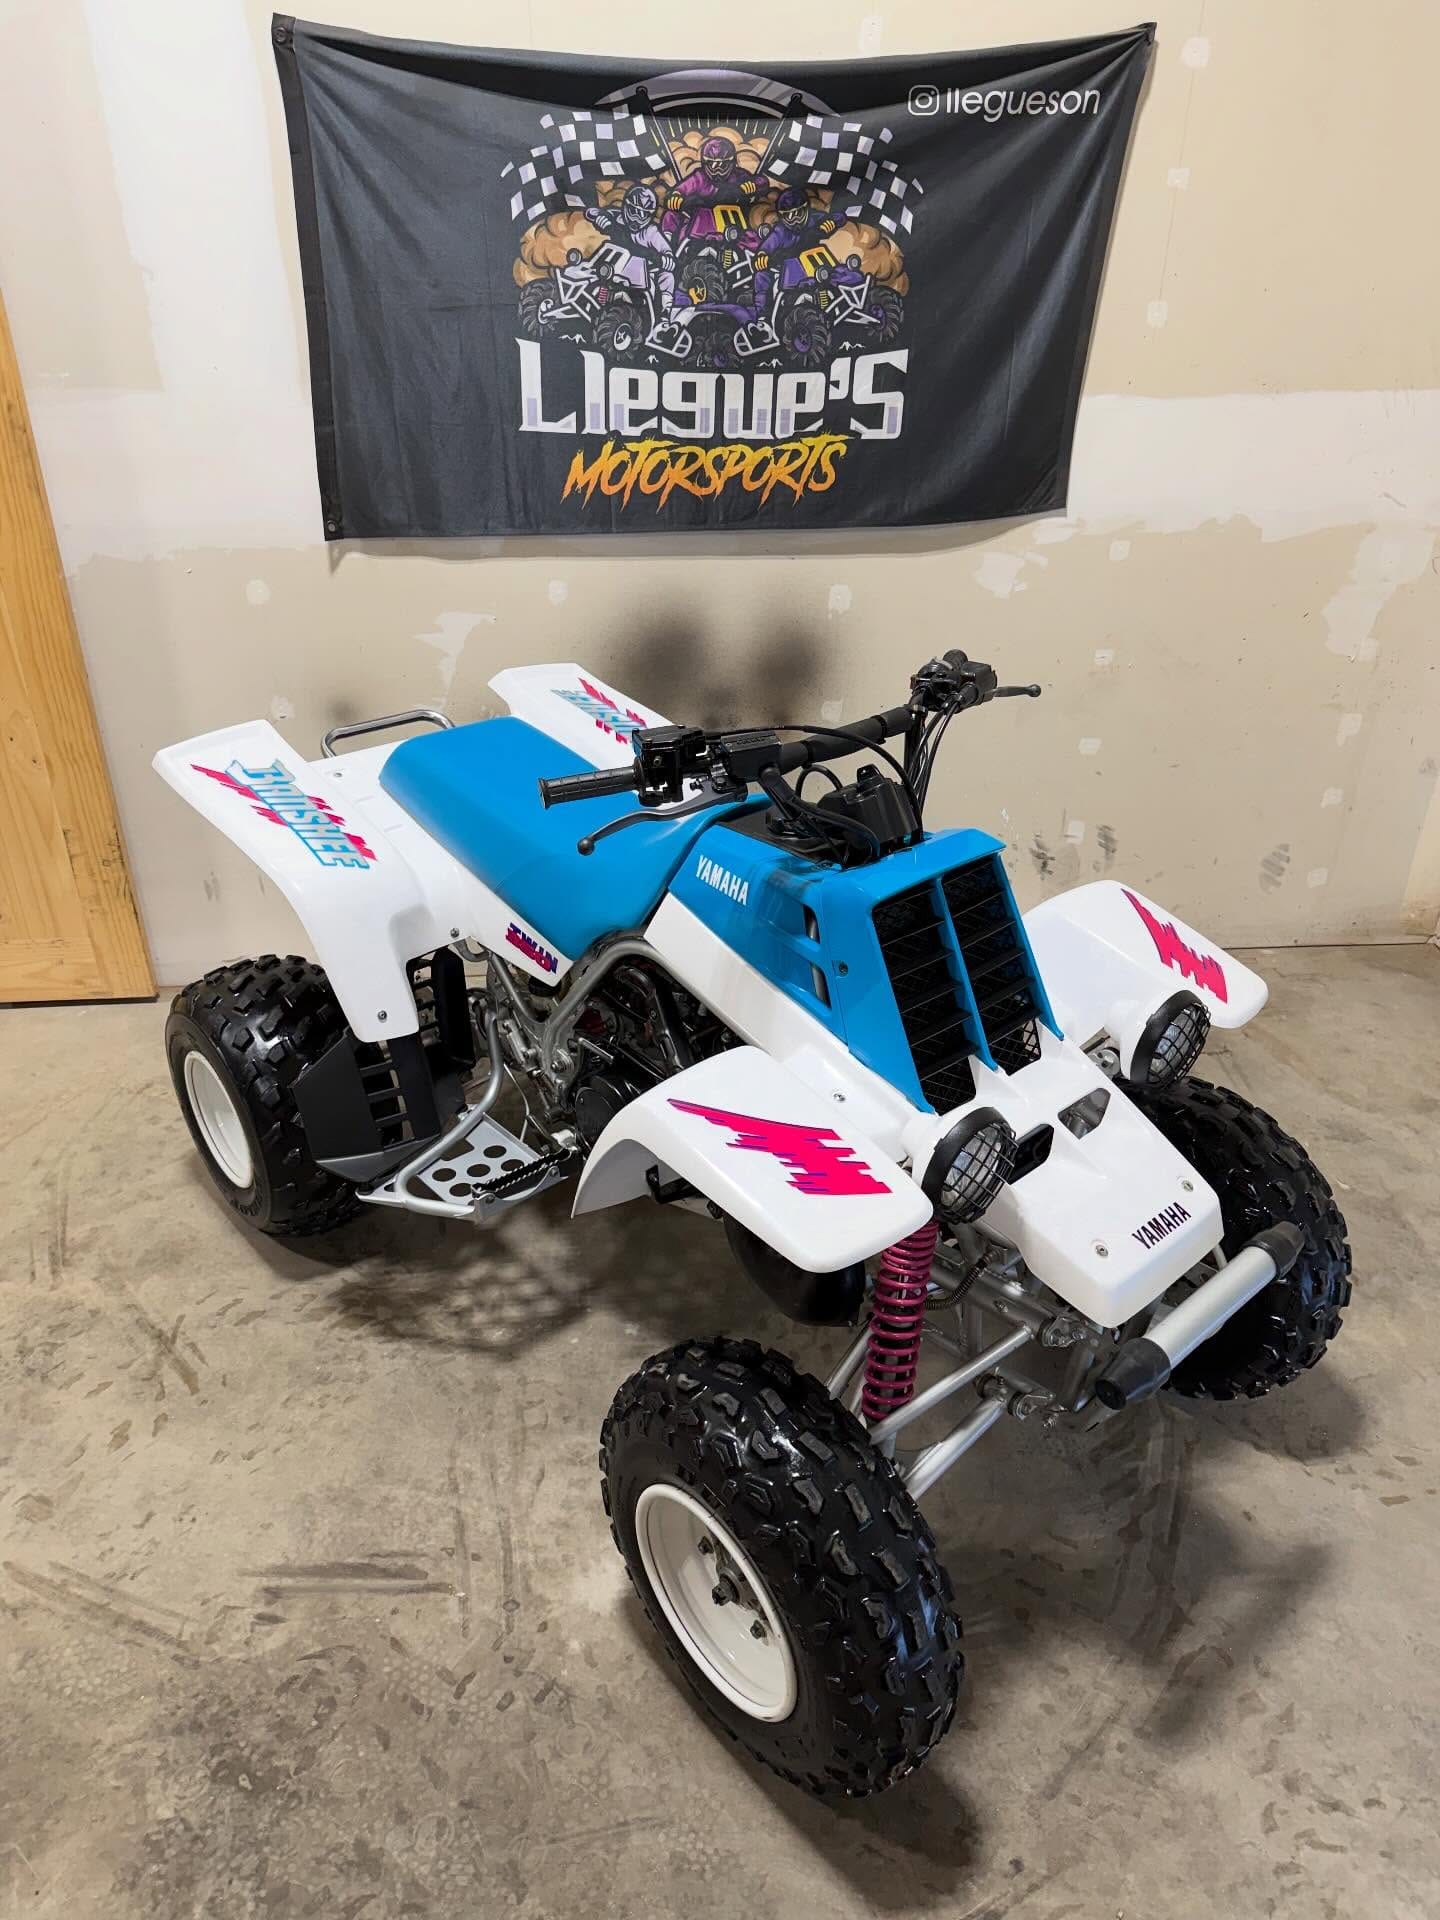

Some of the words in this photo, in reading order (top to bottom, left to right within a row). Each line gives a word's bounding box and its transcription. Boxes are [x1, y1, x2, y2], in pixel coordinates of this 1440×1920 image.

[560, 430, 855, 513] MOTORSPORTS
[225, 759, 370, 869] BANSHEE
[695, 854, 749, 906] YAMAHA
[1131, 1201, 1192, 1249] YAMAHA
